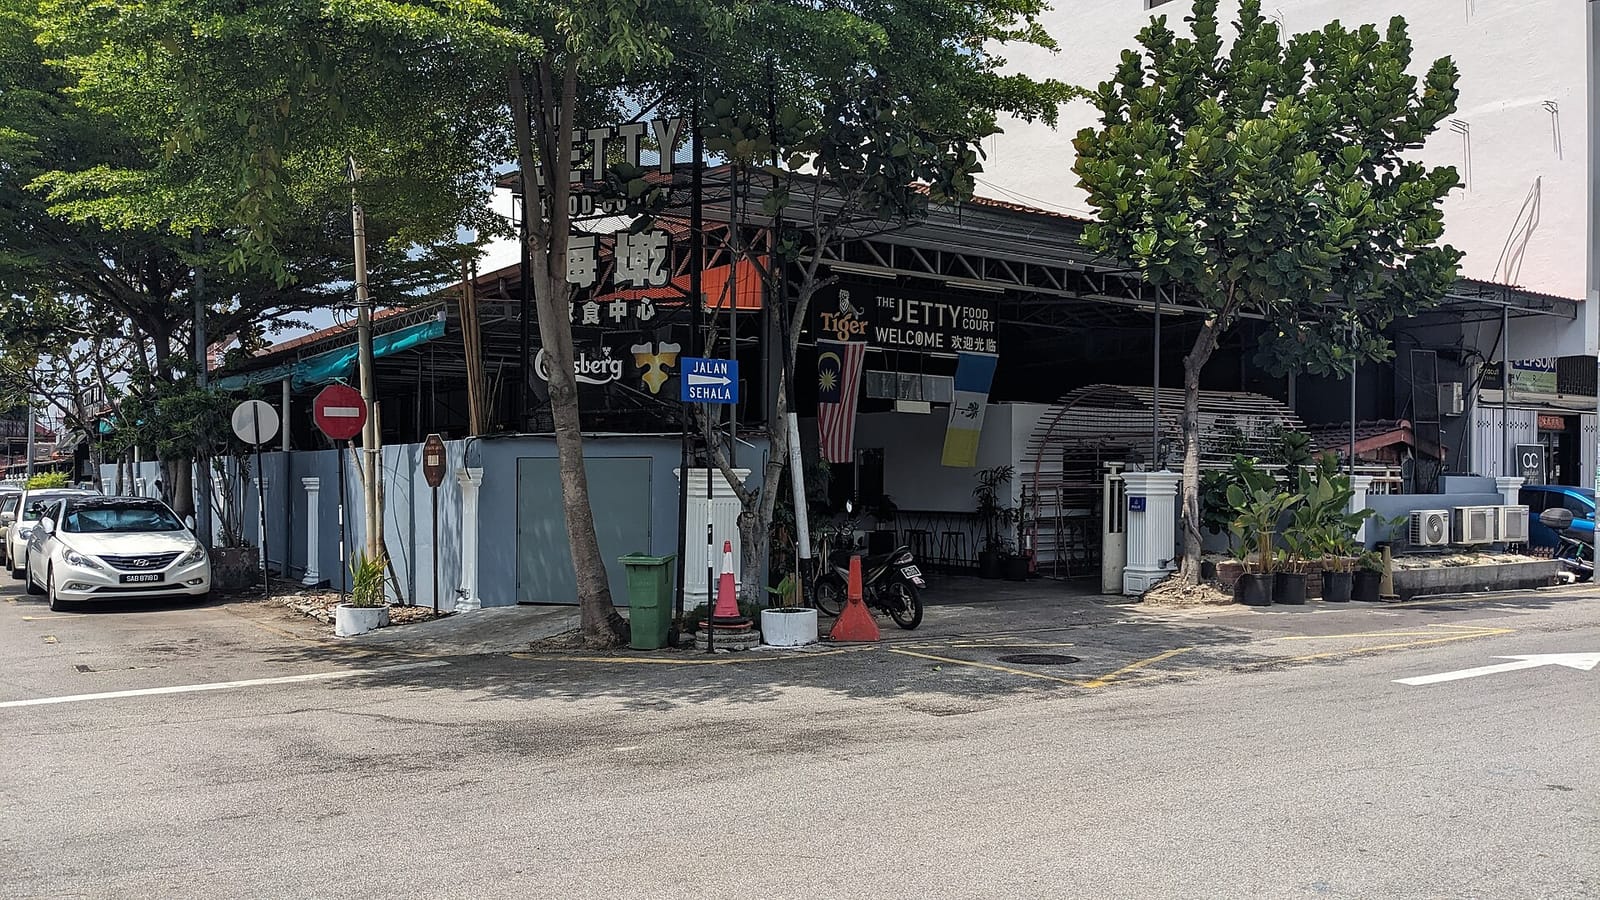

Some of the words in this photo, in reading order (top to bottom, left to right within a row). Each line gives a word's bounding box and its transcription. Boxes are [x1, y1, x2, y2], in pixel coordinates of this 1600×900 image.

[876, 296, 895, 308] THE
[892, 298, 961, 328] JETTY
[962, 307, 989, 319] FOOD
[820, 312, 868, 341] Tiger
[962, 318, 995, 333] COURT
[875, 327, 944, 348] WELCOME
[951, 335, 997, 353] 欢迎光临
[693, 361, 728, 375] JALAN
[689, 386, 732, 400] SEHALA
